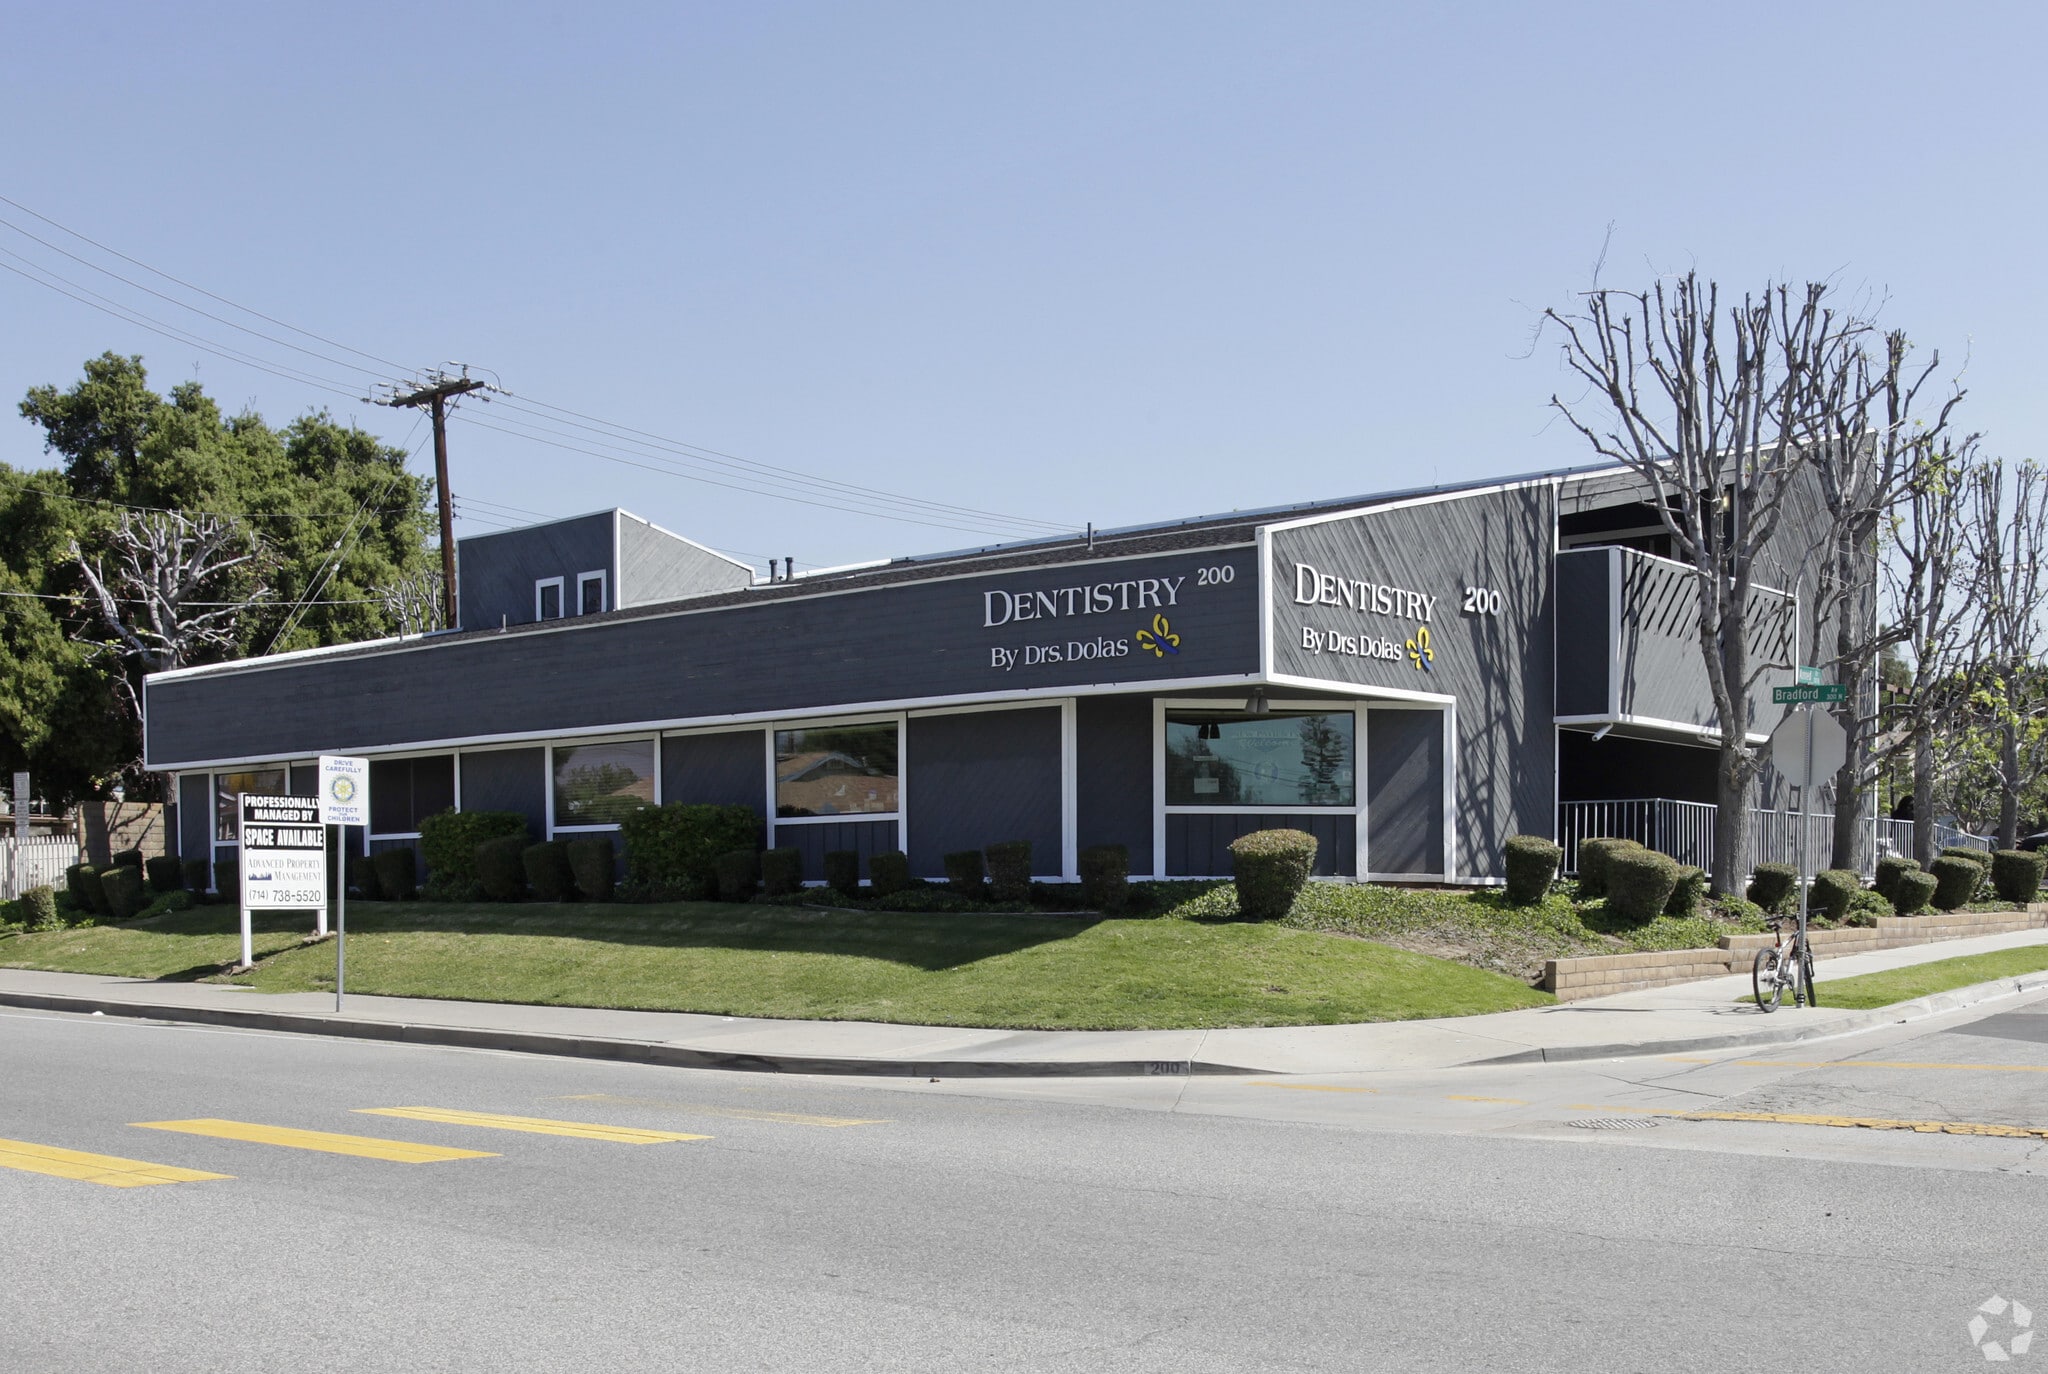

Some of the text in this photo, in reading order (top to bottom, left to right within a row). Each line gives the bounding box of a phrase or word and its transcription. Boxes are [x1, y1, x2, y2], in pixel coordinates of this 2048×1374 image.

[1197, 565, 1235, 586] 200
[1294, 563, 1437, 622] DENTISTRY
[983, 576, 1186, 627] DENTISTRY
[1464, 586, 1501, 616] 200
[1302, 626, 1402, 661] By Drs. Dolas
[991, 637, 1129, 671] By Drs. Dolas
[1775, 688, 1819, 700] Bradford
[325, 765, 361, 773] CAREFULLY
[244, 796, 320, 809] PROFESSIONALLY
[254, 809, 314, 821] MANAGED BY
[245, 828, 323, 847] SPACE AVAILABLE
[248, 858, 320, 868] ADVANCED PROPERTY
[274, 871, 320, 881] MANAGEMENT
[249, 889, 321, 902] (714) 738-5520
[1151, 1062, 1180, 1075] 200
